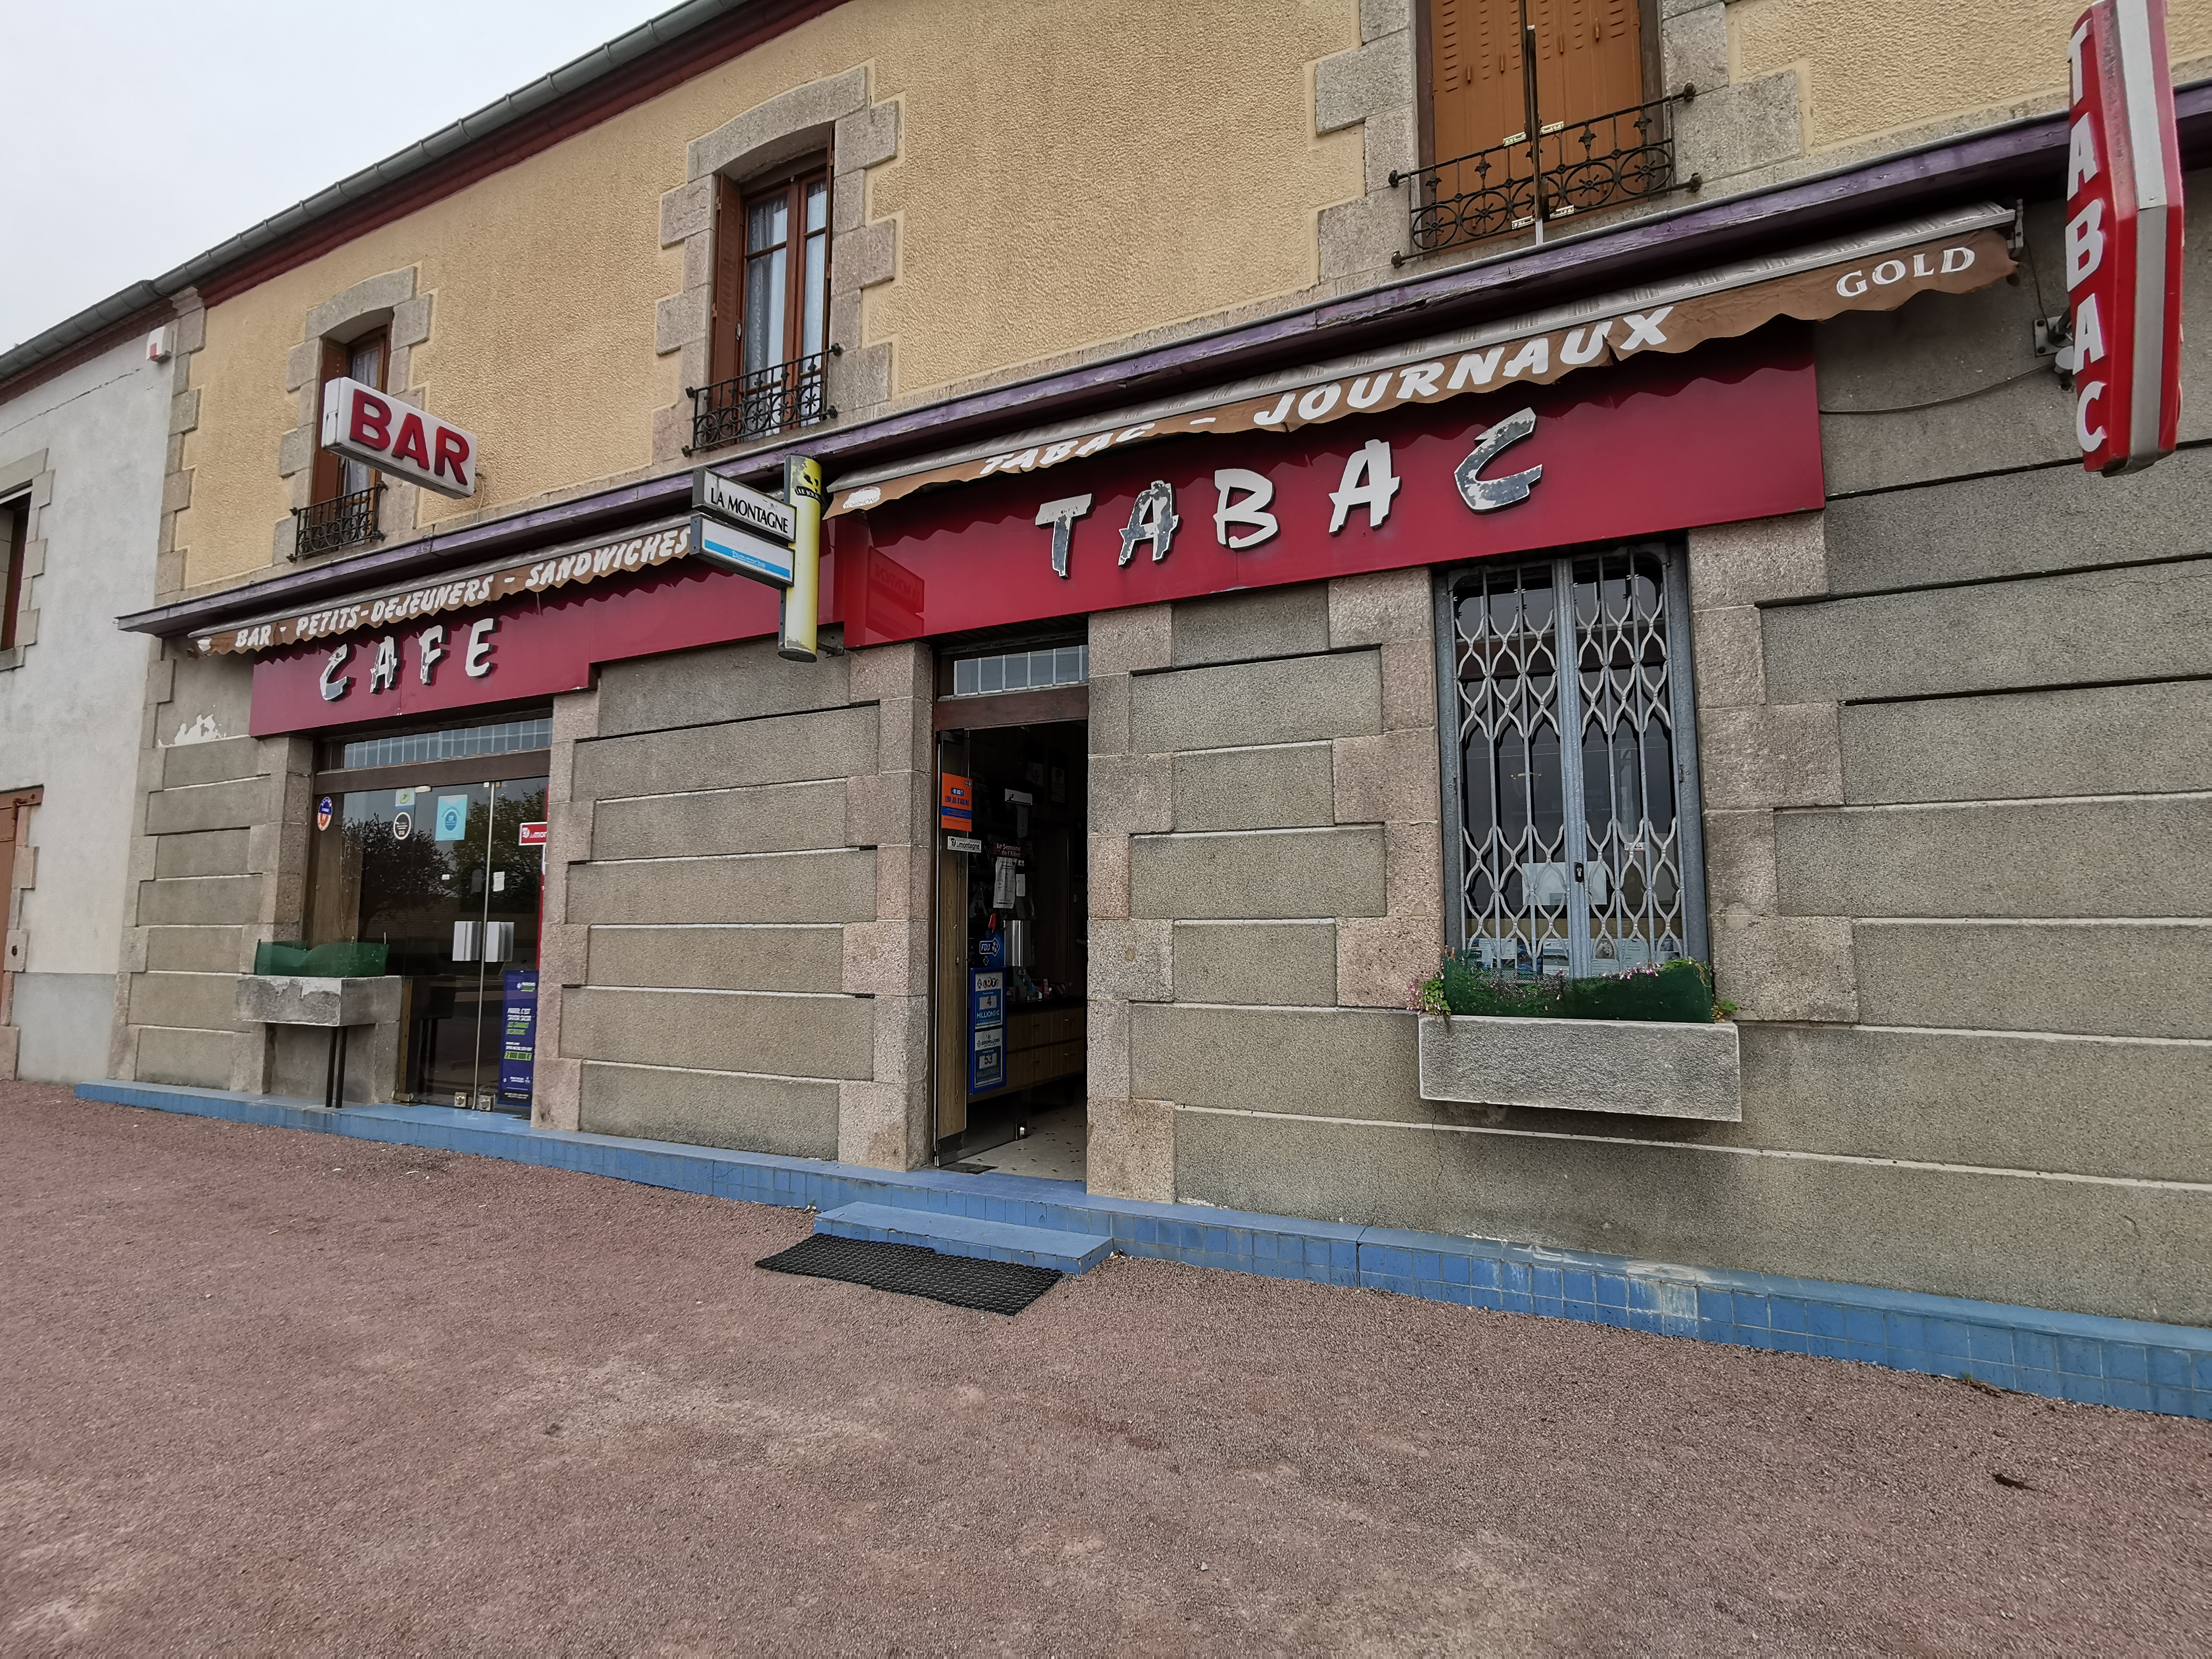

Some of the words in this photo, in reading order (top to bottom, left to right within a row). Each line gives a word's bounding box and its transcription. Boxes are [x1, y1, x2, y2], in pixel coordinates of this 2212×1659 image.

[2065, 19, 2108, 452] TABAC
[1836, 246, 1976, 297] GOLD
[979, 423, 1155, 474] TABAC
[1253, 306, 1674, 425] JOURNAUX
[349, 388, 470, 486] BAR
[711, 487, 725, 508] LA
[727, 494, 789, 534] MONTAGNE
[1035, 407, 1543, 578] TABAC
[235, 625, 271, 647] BAR
[525, 526, 691, 587] SANDWICHES
[319, 618, 499, 702] CAFE
[960, 841, 980, 851] montagne
[981, 943, 990, 951] FDJ
[987, 996, 992, 1006] 4
[984, 1054, 993, 1065] 53
